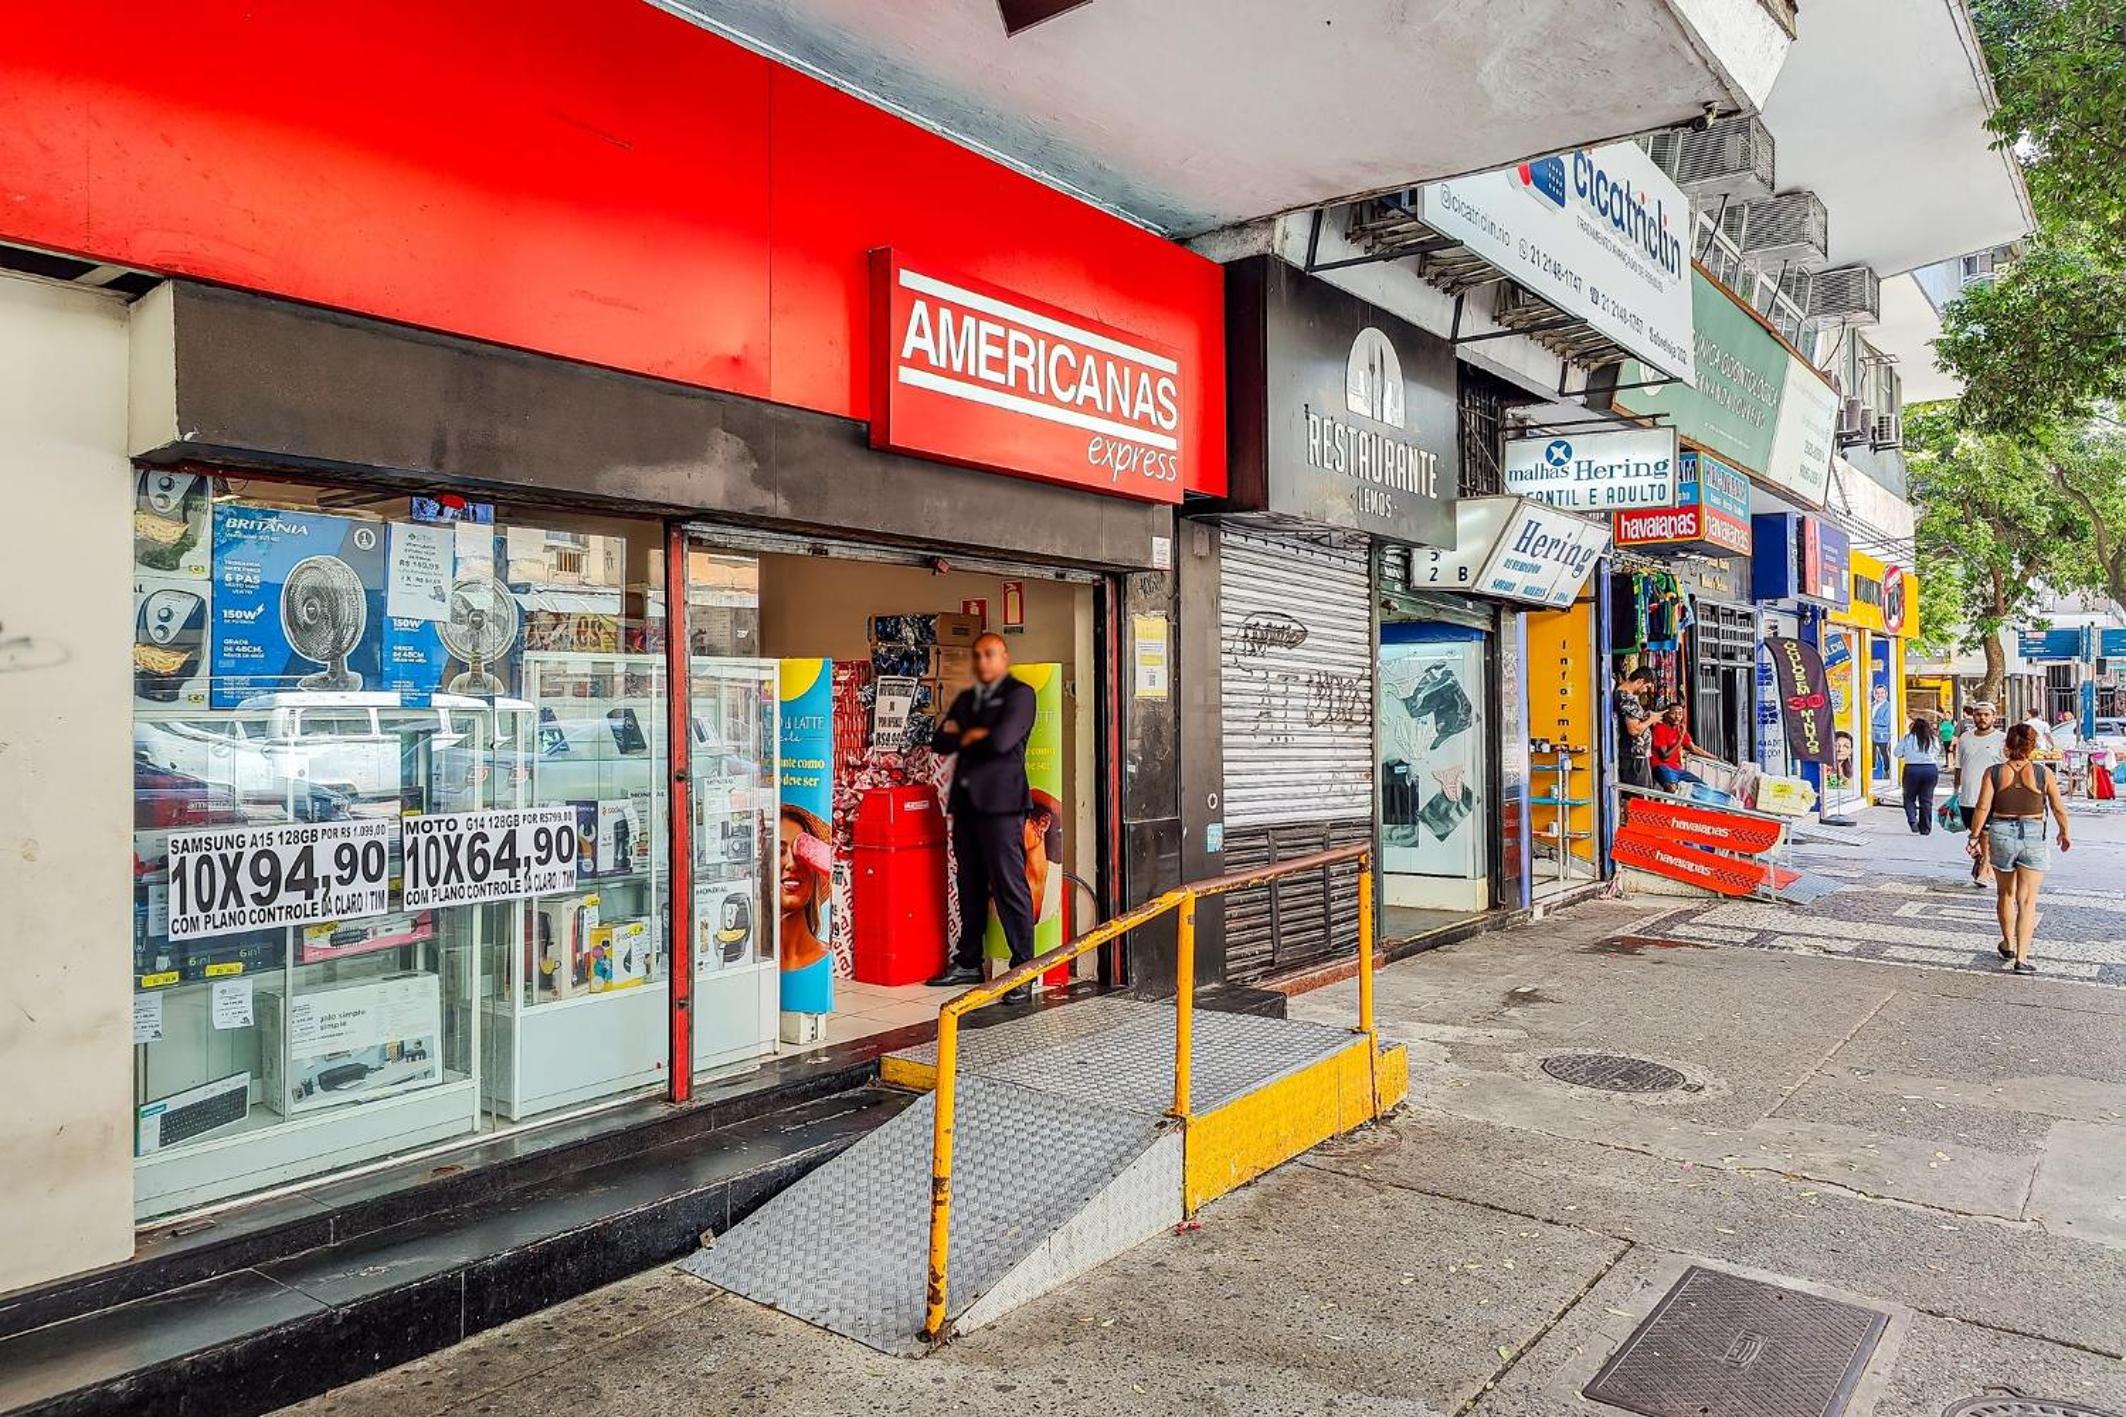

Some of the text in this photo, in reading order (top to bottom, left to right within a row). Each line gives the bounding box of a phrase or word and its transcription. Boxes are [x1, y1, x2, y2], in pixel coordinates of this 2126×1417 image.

[901, 299, 1178, 431] AMERICANAS
[1088, 435, 1177, 483] express
[1307, 412, 1438, 499] RESTAURANTE
[1508, 463, 1570, 482] malhas
[1574, 458, 1669, 481] Hering
[1589, 488, 1597, 505] E
[1607, 484, 1667, 505] ADULTO
[1621, 512, 1696, 539] havaianas
[1512, 519, 1596, 579] Hering
[1429, 566, 1468, 582] 2 B
[1558, 640, 1569, 741] Informá
[793, 716, 825, 729] LATTE
[798, 759, 825, 769] como
[783, 773, 819, 787] deve ser
[405, 818, 458, 835] MOTO
[466, 817, 485, 831] G14
[489, 814, 520, 829] 128GB
[522, 814, 537, 825] POR
[1671, 817, 1730, 838] havaianas
[171, 834, 246, 855] SAMSUNG
[250, 832, 273, 848] A15
[278, 829, 318, 845] 128GB
[321, 828, 338, 839] POR
[406, 825, 575, 889] 10X64,90
[1655, 850, 1713, 877] havaianas
[171, 840, 386, 916] 10X94,90
[406, 890, 428, 906] COM
[432, 884, 465, 902] PLANO
[467, 880, 521, 899] CONTROLE
[534, 873, 556, 892] CLARO
[171, 915, 200, 935] COM
[204, 909, 246, 930] PLANO
[250, 902, 318, 925] CONTROLE
[335, 894, 362, 915] CLARO
[370, 890, 385, 910] TIM
